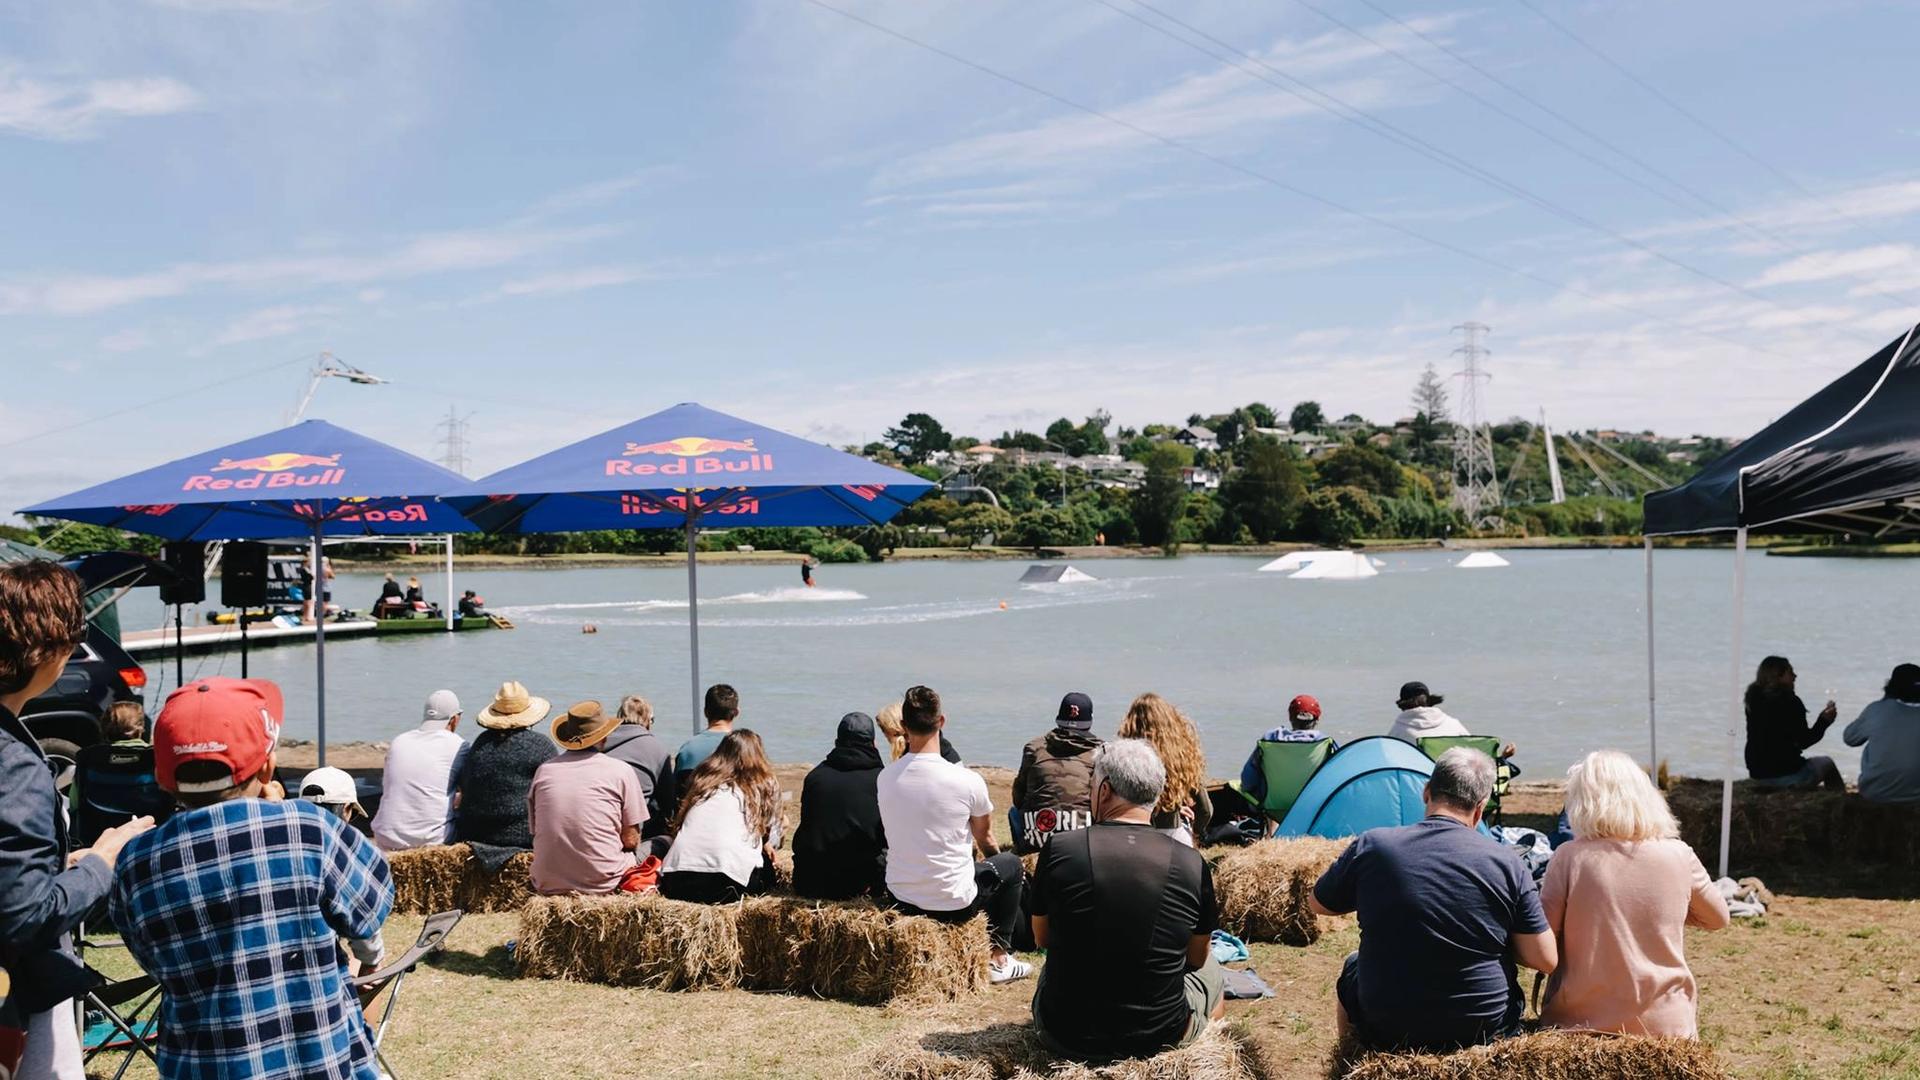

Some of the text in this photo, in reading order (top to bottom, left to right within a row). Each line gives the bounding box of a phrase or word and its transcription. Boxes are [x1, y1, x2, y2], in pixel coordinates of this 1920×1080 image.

[605, 454, 774, 476] Red Bull
[182, 468, 346, 491] Red Bull
